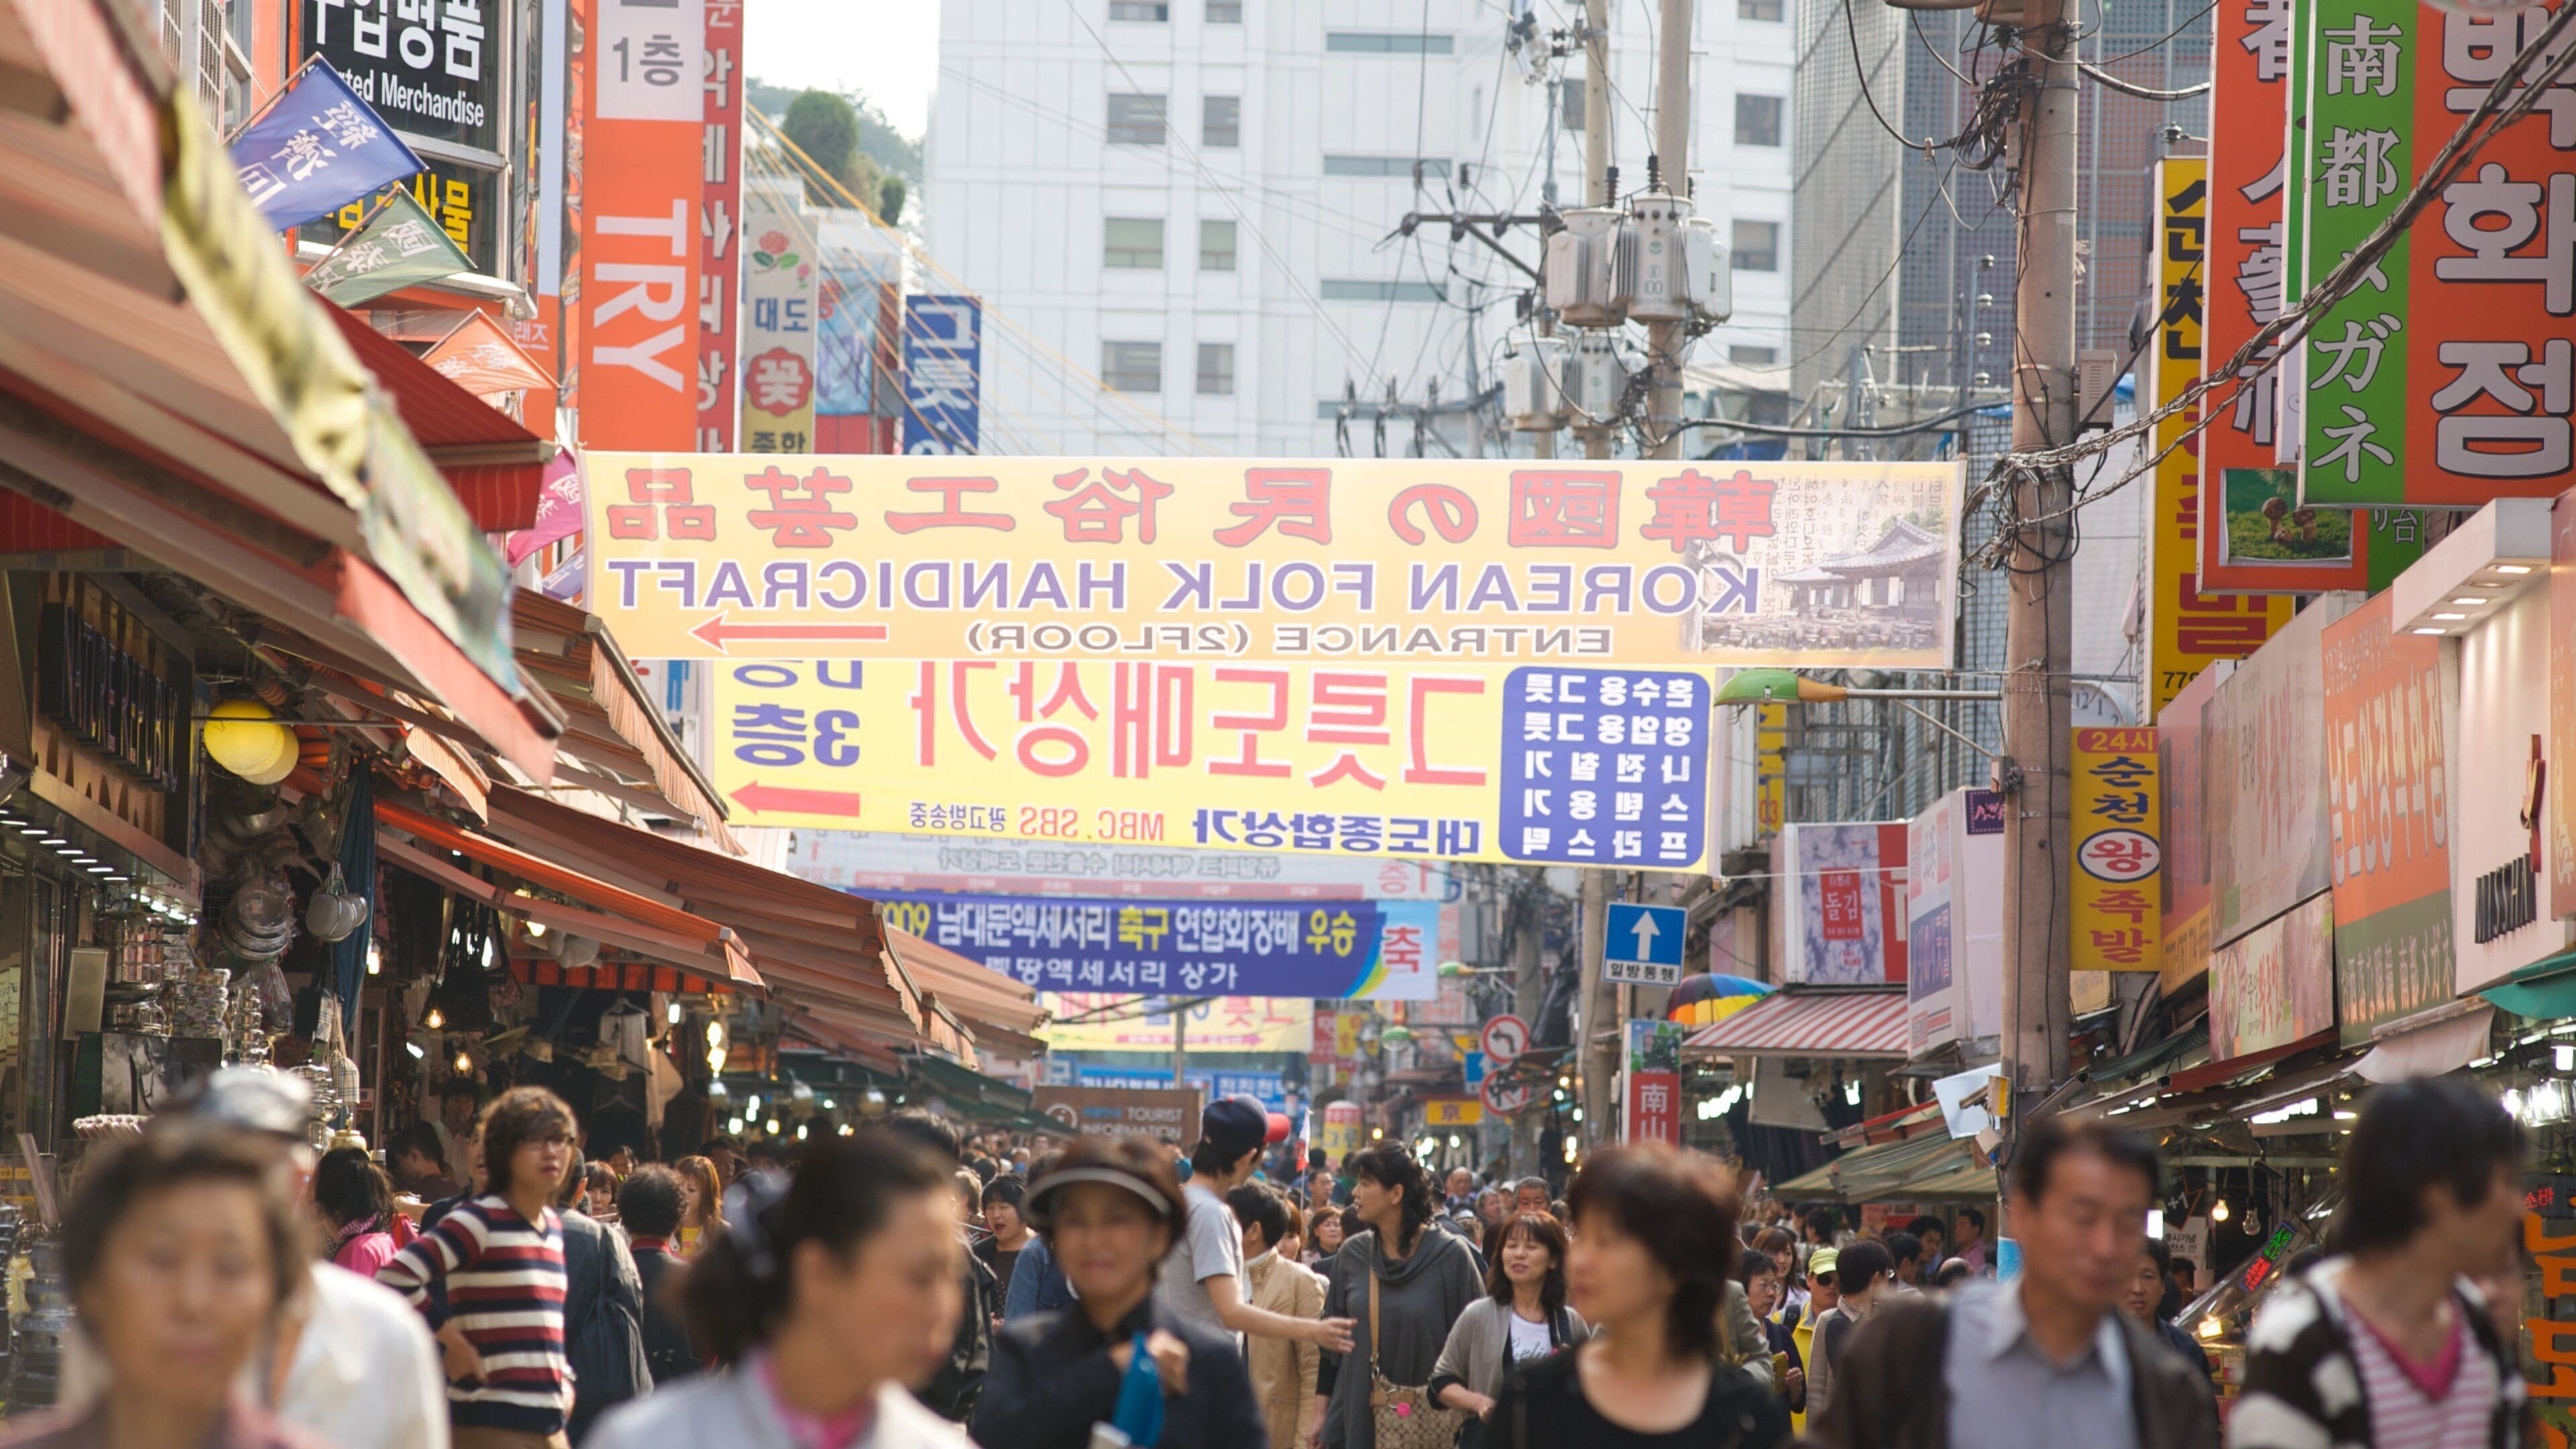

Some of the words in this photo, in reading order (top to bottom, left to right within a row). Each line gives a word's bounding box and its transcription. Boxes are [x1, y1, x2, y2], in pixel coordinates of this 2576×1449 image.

[611, 34, 684, 87] 1층
[381, 72, 484, 127] Merchandise
[593, 199, 688, 393] TRY
[755, 297, 808, 333] 대도
[755, 360, 804, 407] 꽃
[2091, 730, 2154, 752] 24시
[2088, 756, 2155, 823] 순천
[1825, 891, 1858, 921] 돌김
[2088, 889, 2153, 963] 족발
[1117, 908, 1169, 951] 축구
[1305, 910, 1357, 956] 우승
[1382, 924, 1423, 974] 축
[1179, 959, 1238, 989] 상가
[1610, 962, 1674, 982] 일방통행
